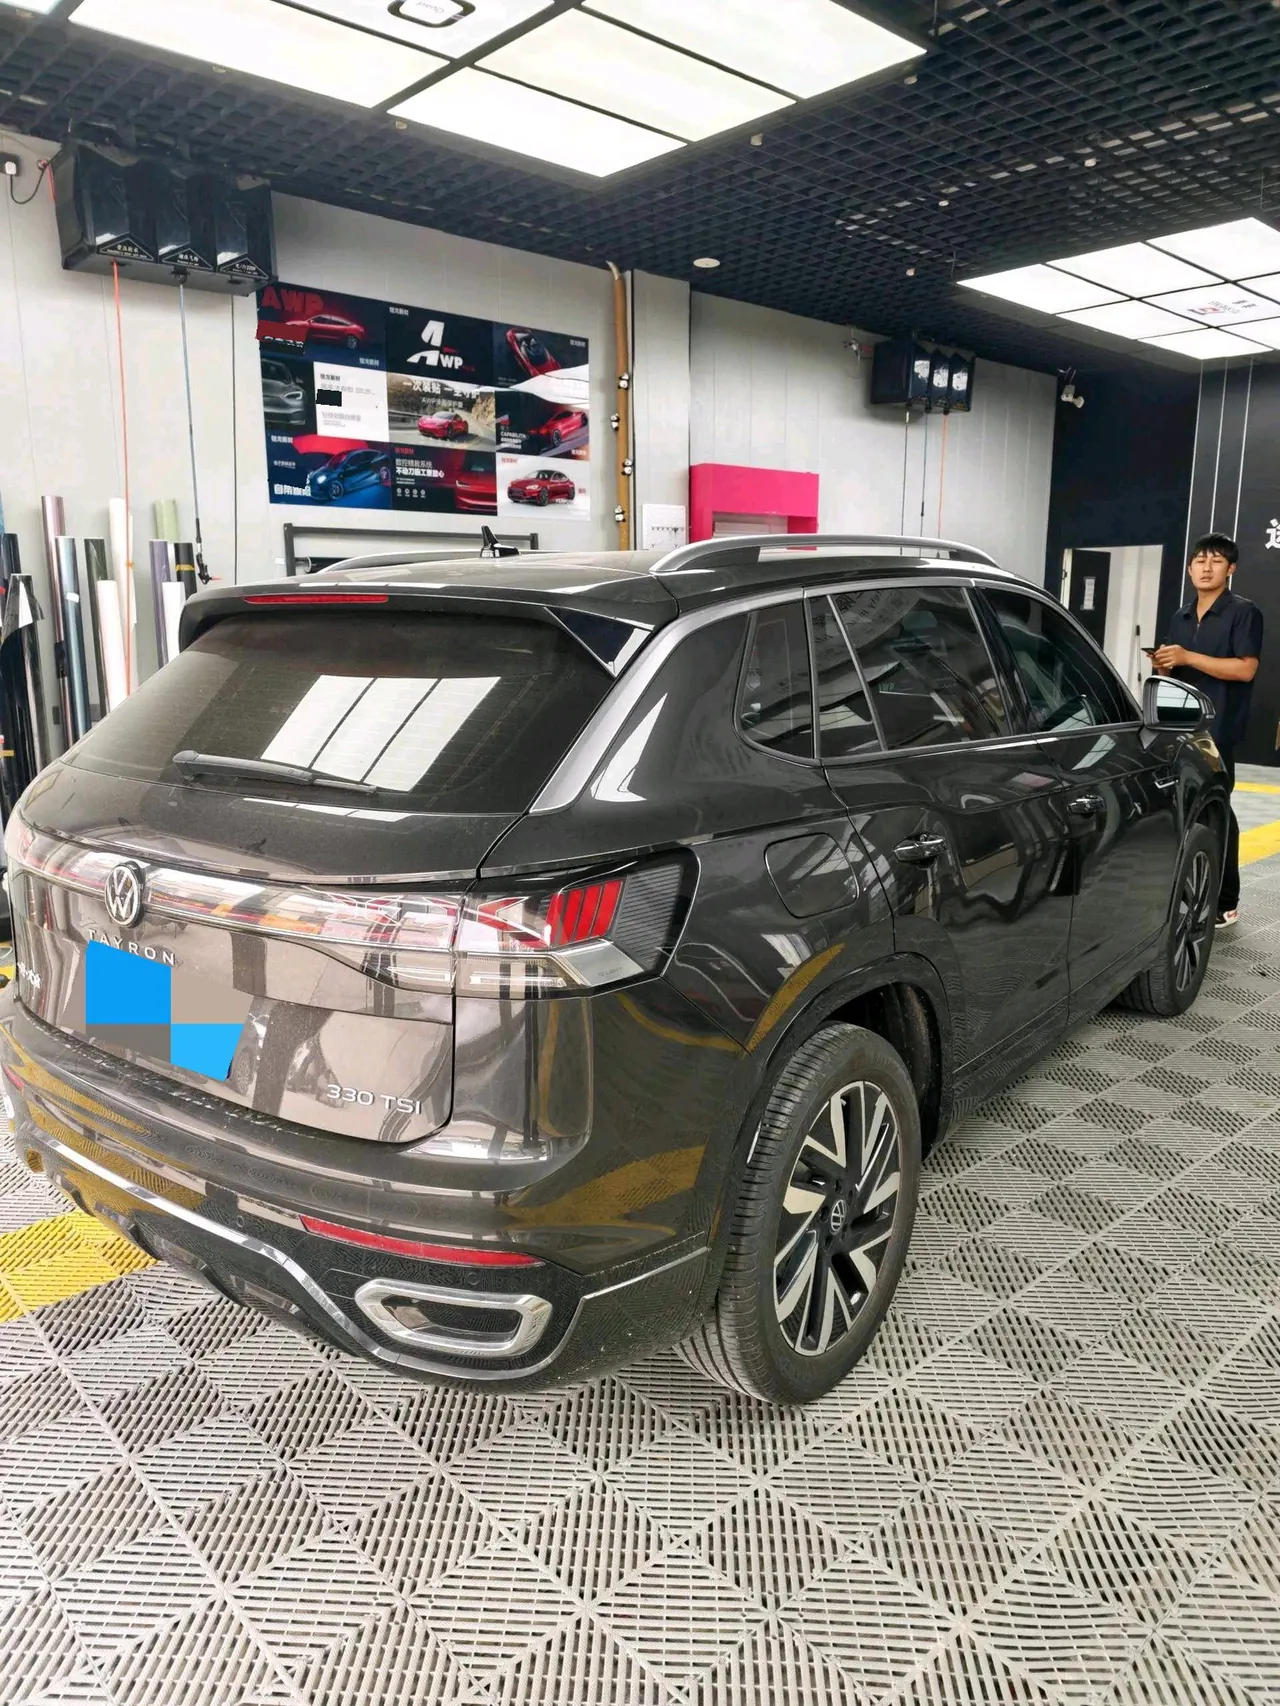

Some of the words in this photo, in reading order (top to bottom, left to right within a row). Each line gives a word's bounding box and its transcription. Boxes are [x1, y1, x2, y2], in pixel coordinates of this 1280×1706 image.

[262, 286, 324, 314] AWP
[89, 929, 175, 966] TAYRON
[327, 1084, 374, 1106] 330
[380, 1094, 421, 1115] TSI
